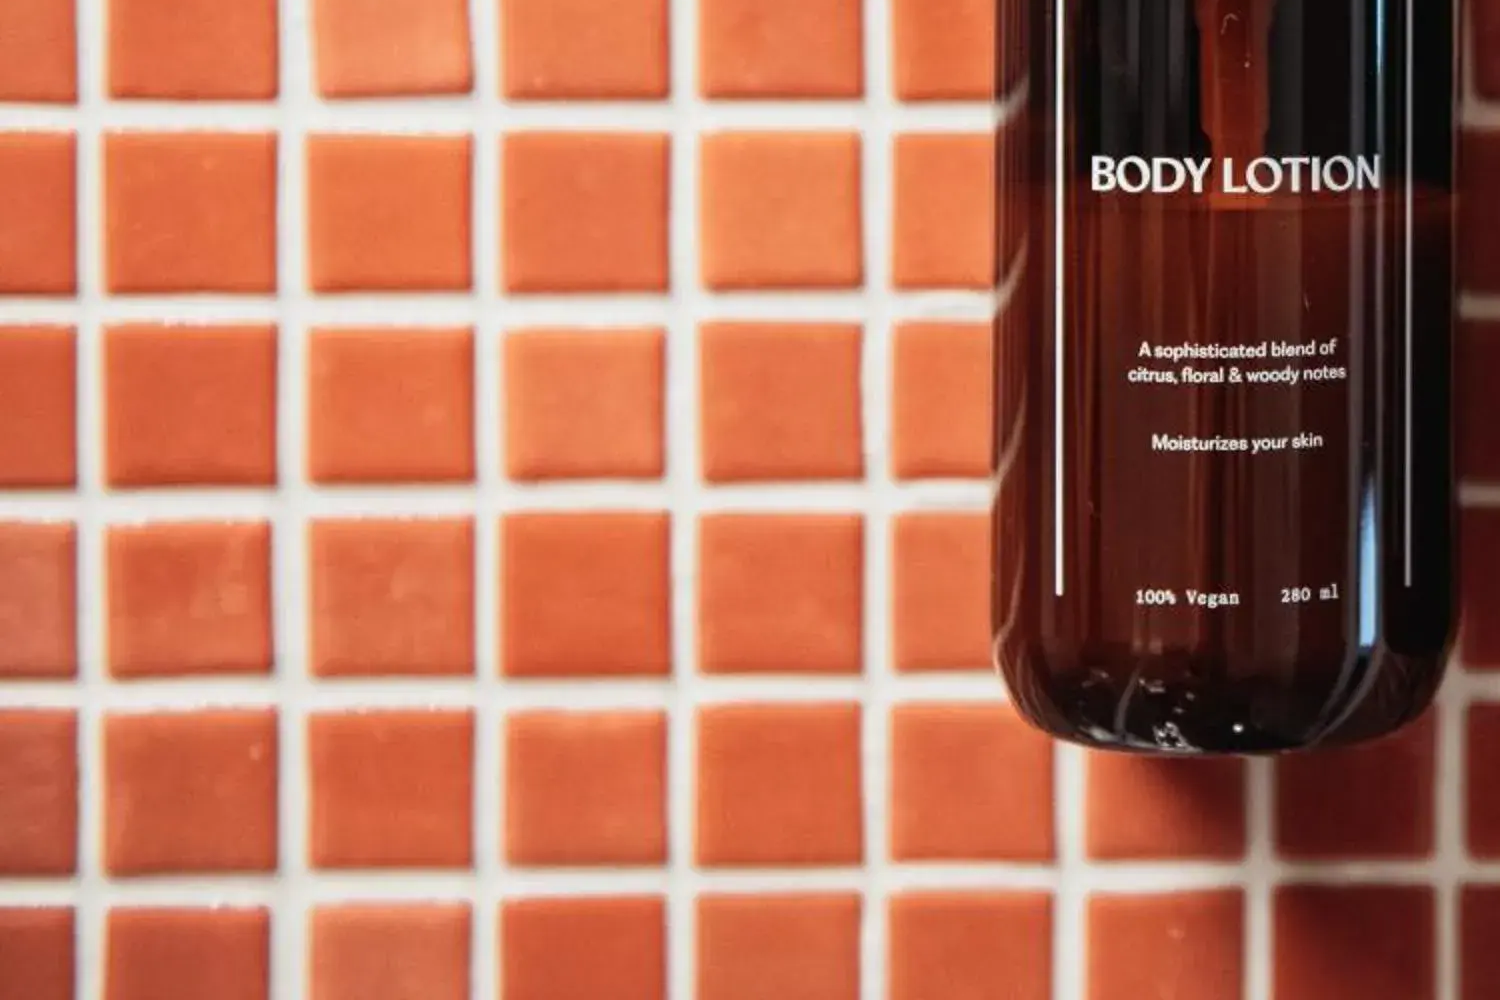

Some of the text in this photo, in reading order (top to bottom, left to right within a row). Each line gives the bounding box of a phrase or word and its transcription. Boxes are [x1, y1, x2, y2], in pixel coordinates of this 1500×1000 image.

[1091, 153, 1382, 195] BODY LOTION
[1137, 337, 1338, 364] A sophisticated blend of
[1127, 364, 1347, 386] citrus, floral & woody notes
[1151, 432, 1324, 455] Moisturizes your skin
[1135, 588, 1240, 609] 100% Vegan
[1281, 583, 1339, 604] 280 ml
